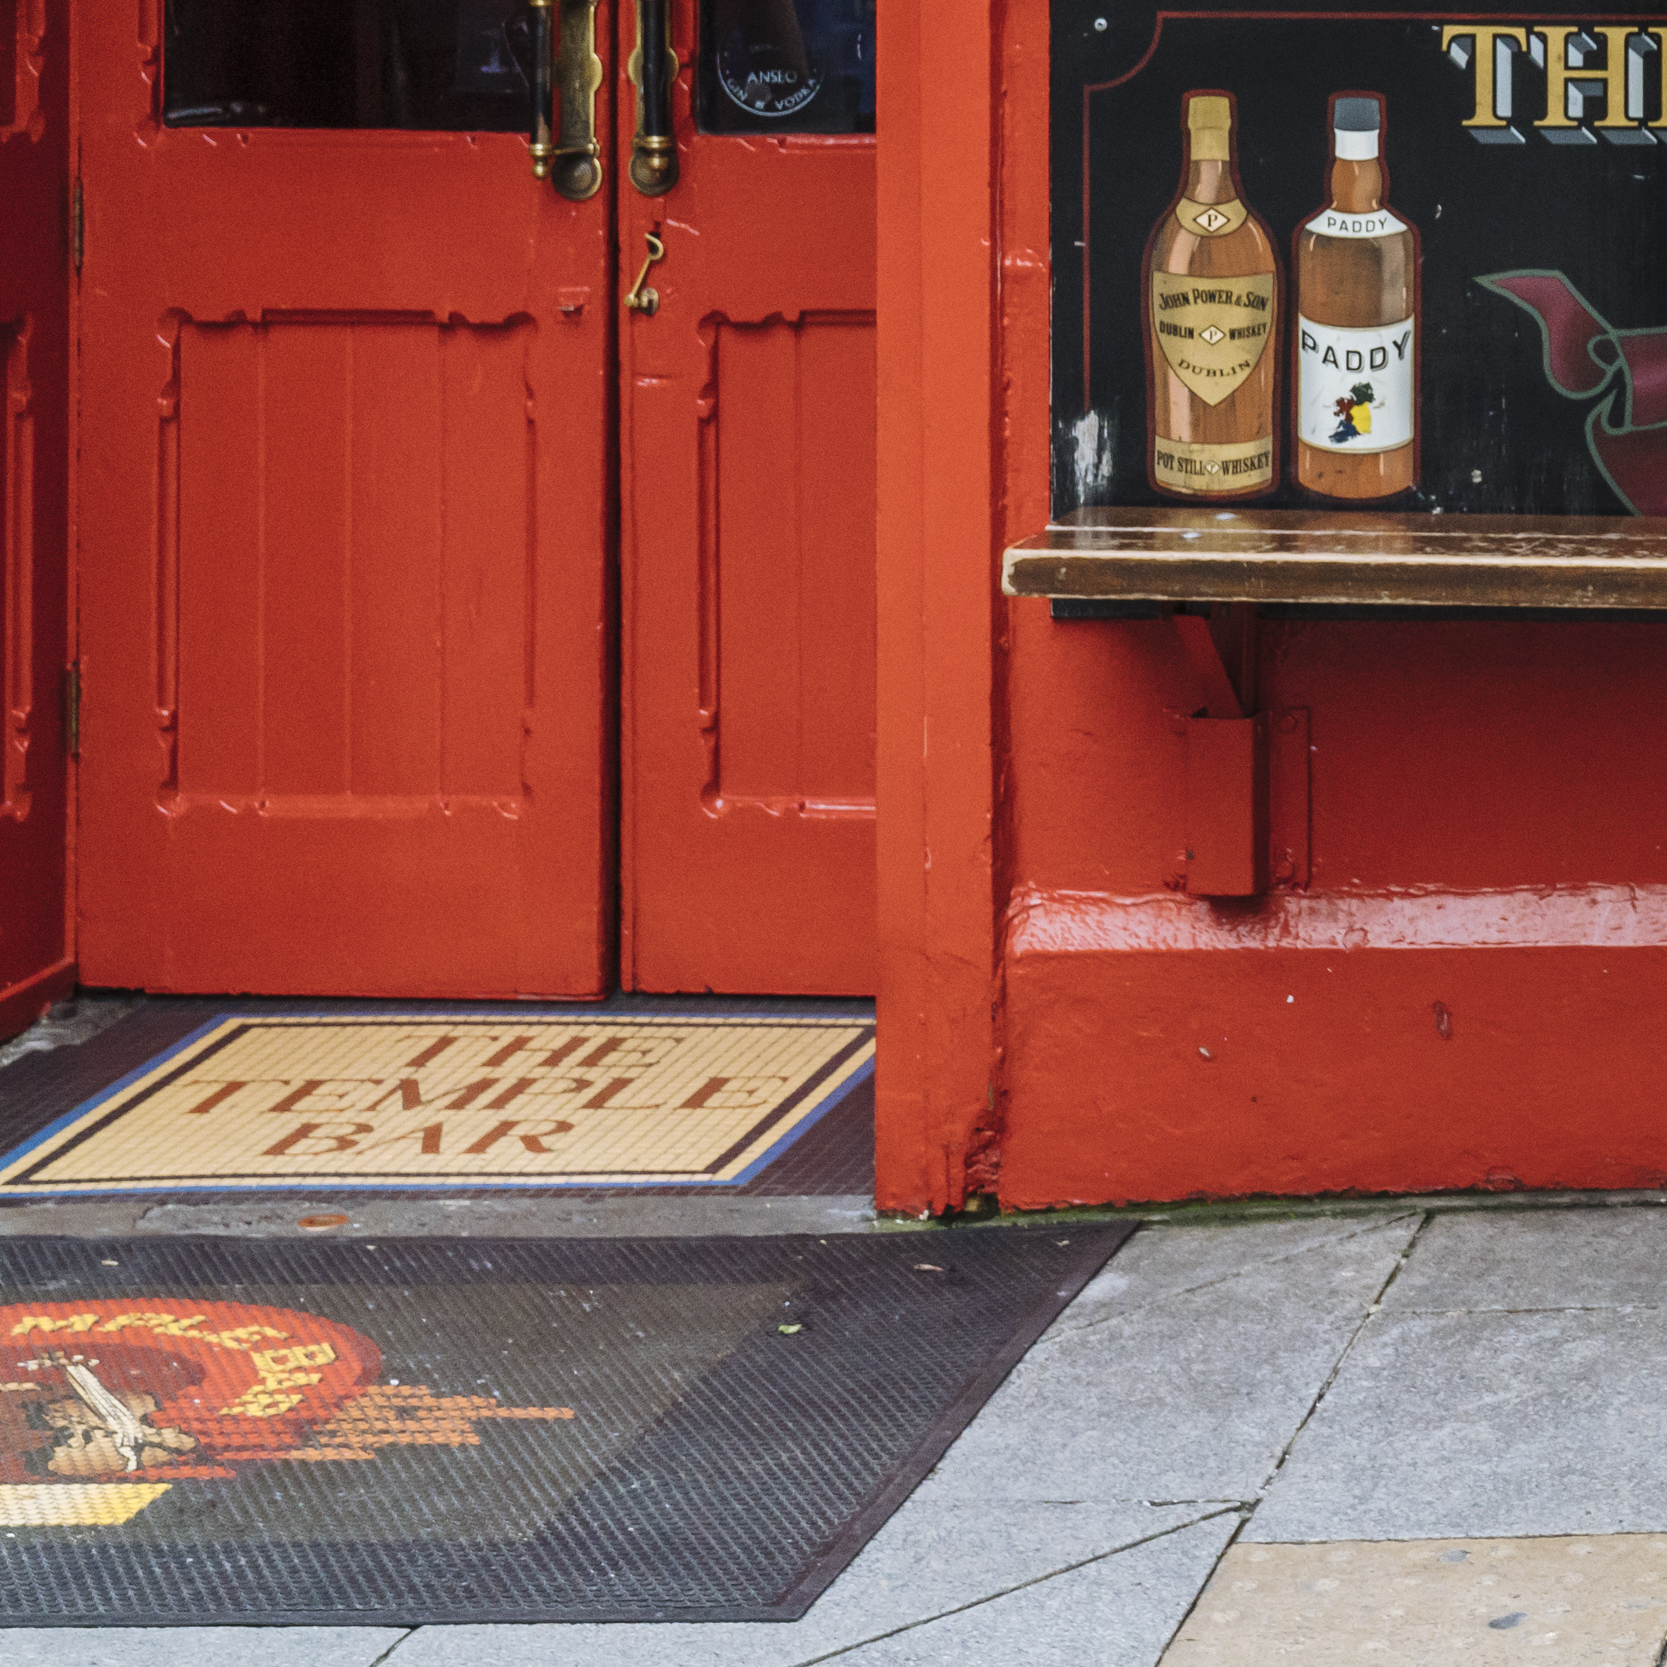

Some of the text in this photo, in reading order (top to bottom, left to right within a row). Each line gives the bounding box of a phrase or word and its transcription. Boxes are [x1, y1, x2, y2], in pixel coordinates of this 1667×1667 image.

[1208, 214, 1219, 227] P
[1327, 217, 1388, 233] PADDY
[1159, 288, 1270, 312] JOHN POWER & SON
[1159, 320, 1194, 340] DUBLIN
[1229, 322, 1267, 341] WHISKEY
[1301, 329, 1412, 373] PADDY
[1178, 358, 1251, 378] DUBLIN
[1157, 449, 1270, 476] POT STILL WHISKEY
[397, 1034, 684, 1069] THE
[180, 1075, 788, 1115] TEMPLE
[262, 1118, 575, 1157] BAR
